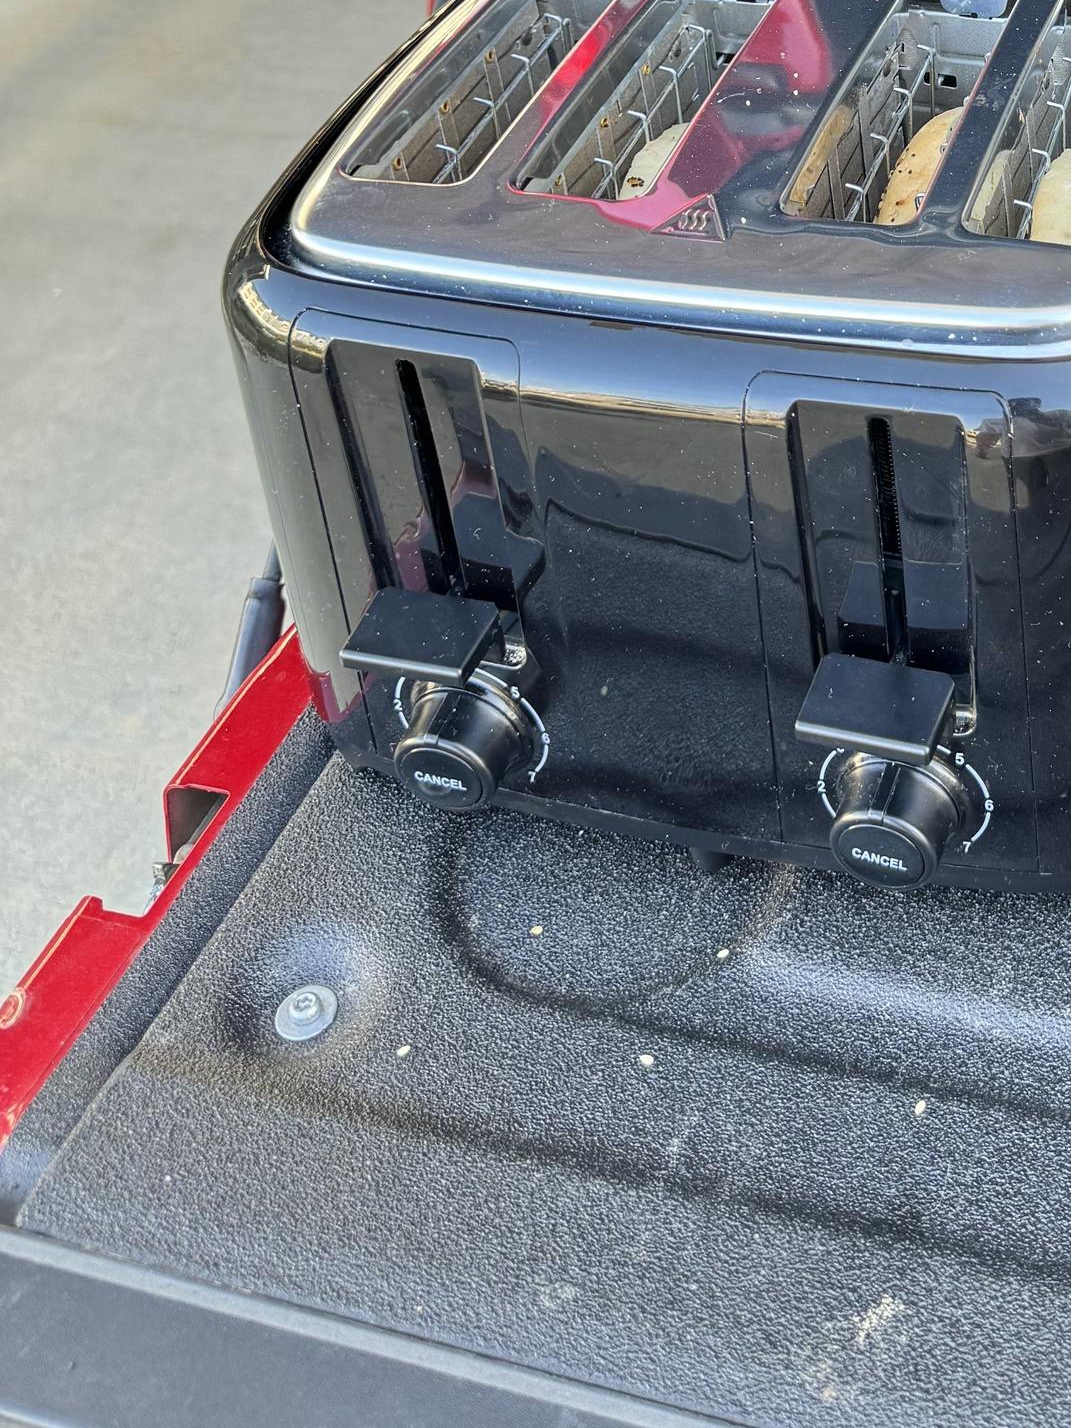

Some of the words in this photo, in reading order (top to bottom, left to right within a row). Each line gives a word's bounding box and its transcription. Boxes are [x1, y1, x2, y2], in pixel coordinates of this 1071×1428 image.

[510, 686, 520, 699] 5
[393, 698, 403, 711] 2
[541, 732, 551, 744] 6
[955, 752, 965, 766] 5
[414, 770, 468, 792] CANCEL
[527, 771, 537, 783] 7
[817, 780, 827, 792] 2
[984, 799, 994, 812] 6
[962, 841, 972, 854] 7
[851, 847, 908, 872] CANCEL
